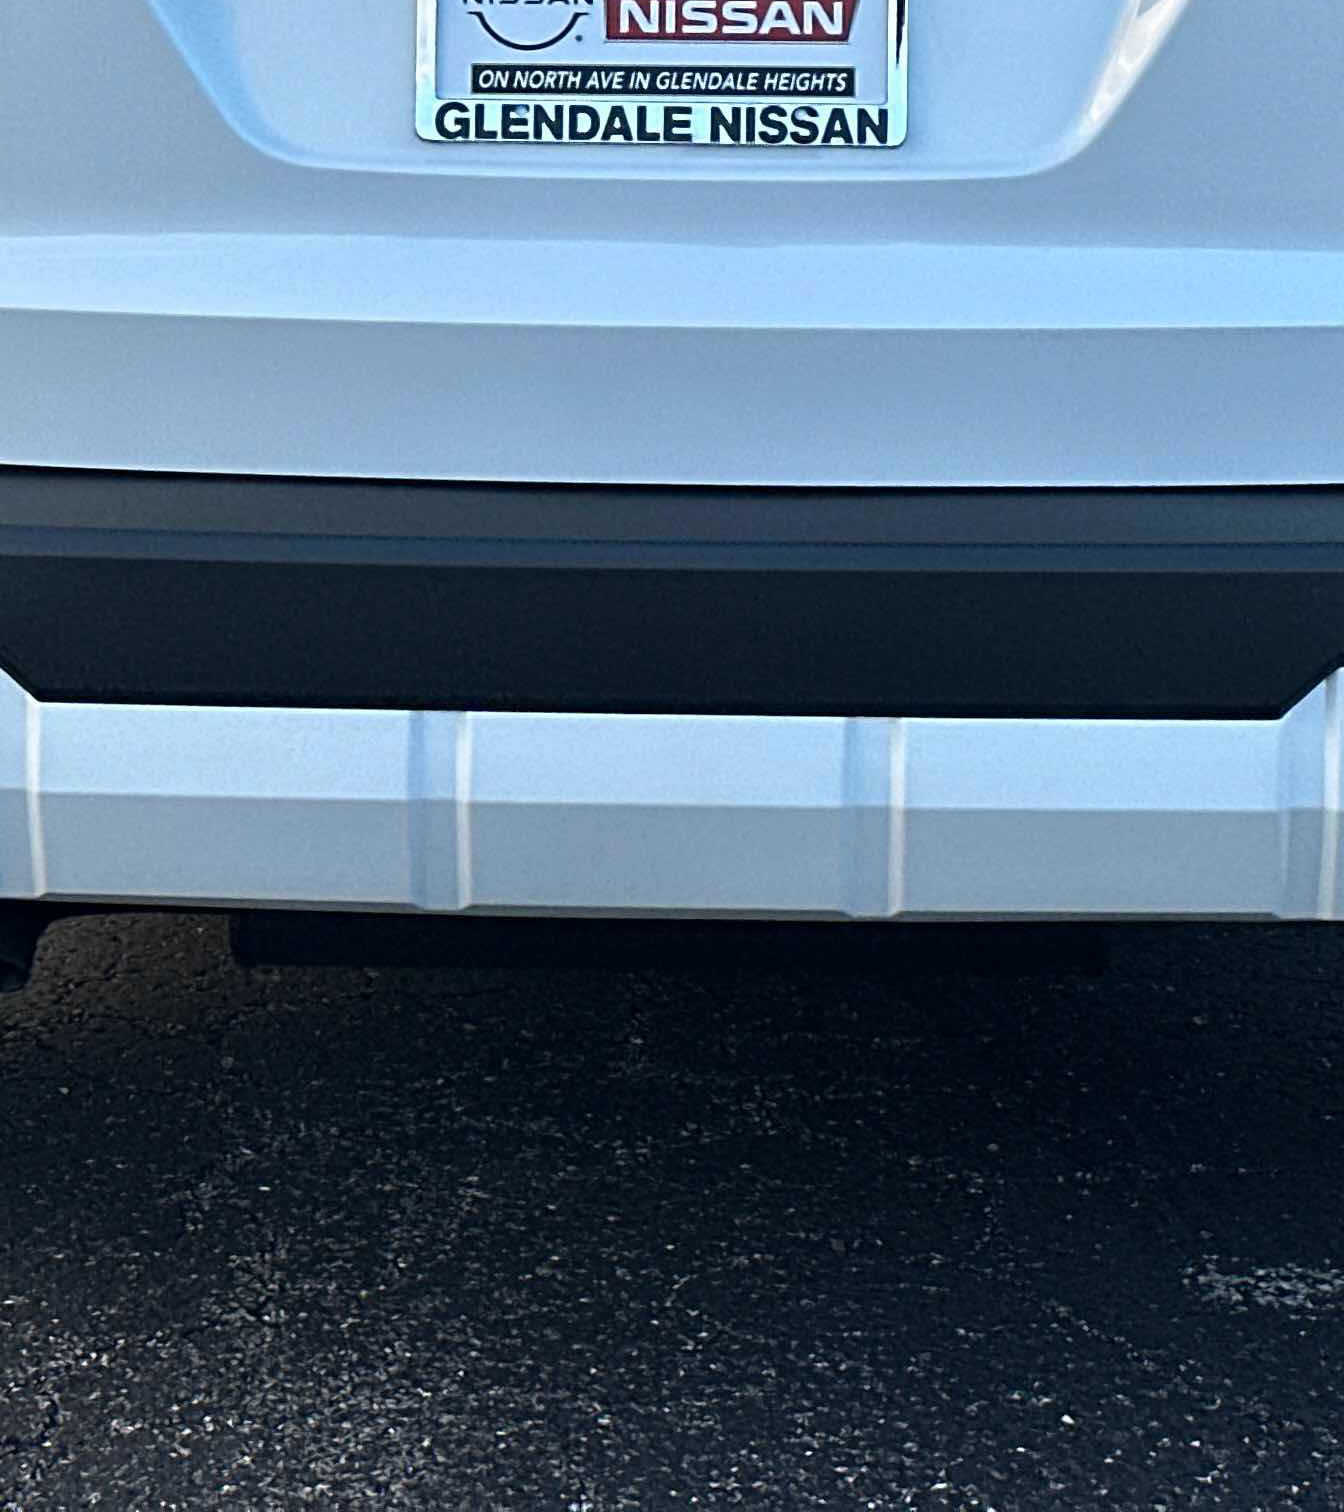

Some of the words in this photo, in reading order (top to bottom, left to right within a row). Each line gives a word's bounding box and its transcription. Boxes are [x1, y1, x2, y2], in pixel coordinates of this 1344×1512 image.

[619, 0, 844, 35] NISSAN
[478, 70, 509, 89] ON
[512, 71, 581, 90] NORTH
[585, 71, 625, 90] AVE
[629, 72, 651, 90] IN
[655, 71, 758, 92] GLENDALE
[763, 72, 848, 93] HEIGHTS
[434, 101, 693, 142] GLENDALE
[710, 104, 889, 144] NISSAN
